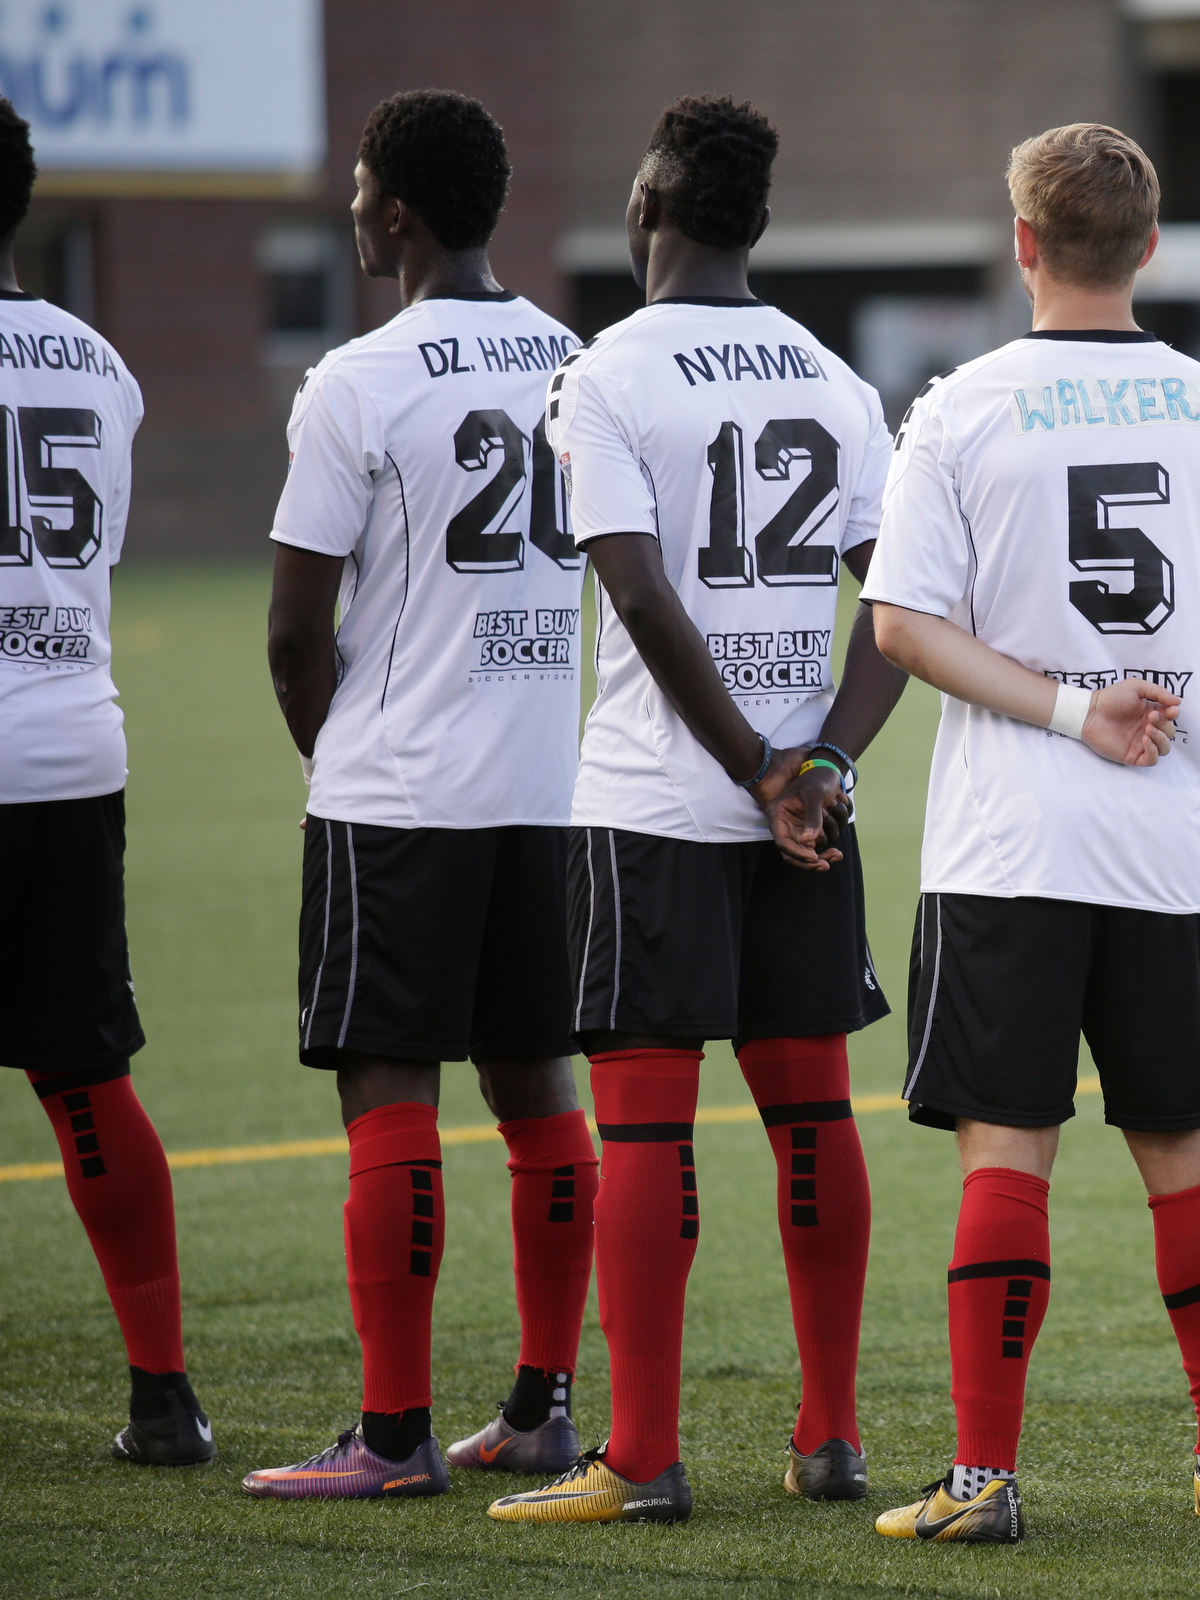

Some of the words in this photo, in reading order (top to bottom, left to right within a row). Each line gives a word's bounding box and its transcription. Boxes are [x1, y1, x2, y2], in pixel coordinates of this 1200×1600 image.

[418, 338, 476, 378] DZ.
[477, 335, 580, 372] HARMO
[673, 343, 829, 386] NYAMBI
[1014, 378, 1200, 432] WALKER
[0, 404, 103, 569] 15
[698, 418, 840, 589] 12
[1067, 462, 1175, 635] 5
[54, 607, 92, 633] BUY
[473, 610, 528, 638] BEST
[535, 609, 580, 635] BUY
[0, 630, 90, 660] OCCER
[480, 638, 570, 666] SOCCER
[706, 632, 774, 660] BEST
[776, 630, 831, 658] BUY
[468, 674, 530, 683] SOCCER
[722, 660, 823, 690] SOCCER
[382, 1473, 432, 1490] MERCURIAL
[621, 1497, 673, 1511] MERCURIAL
